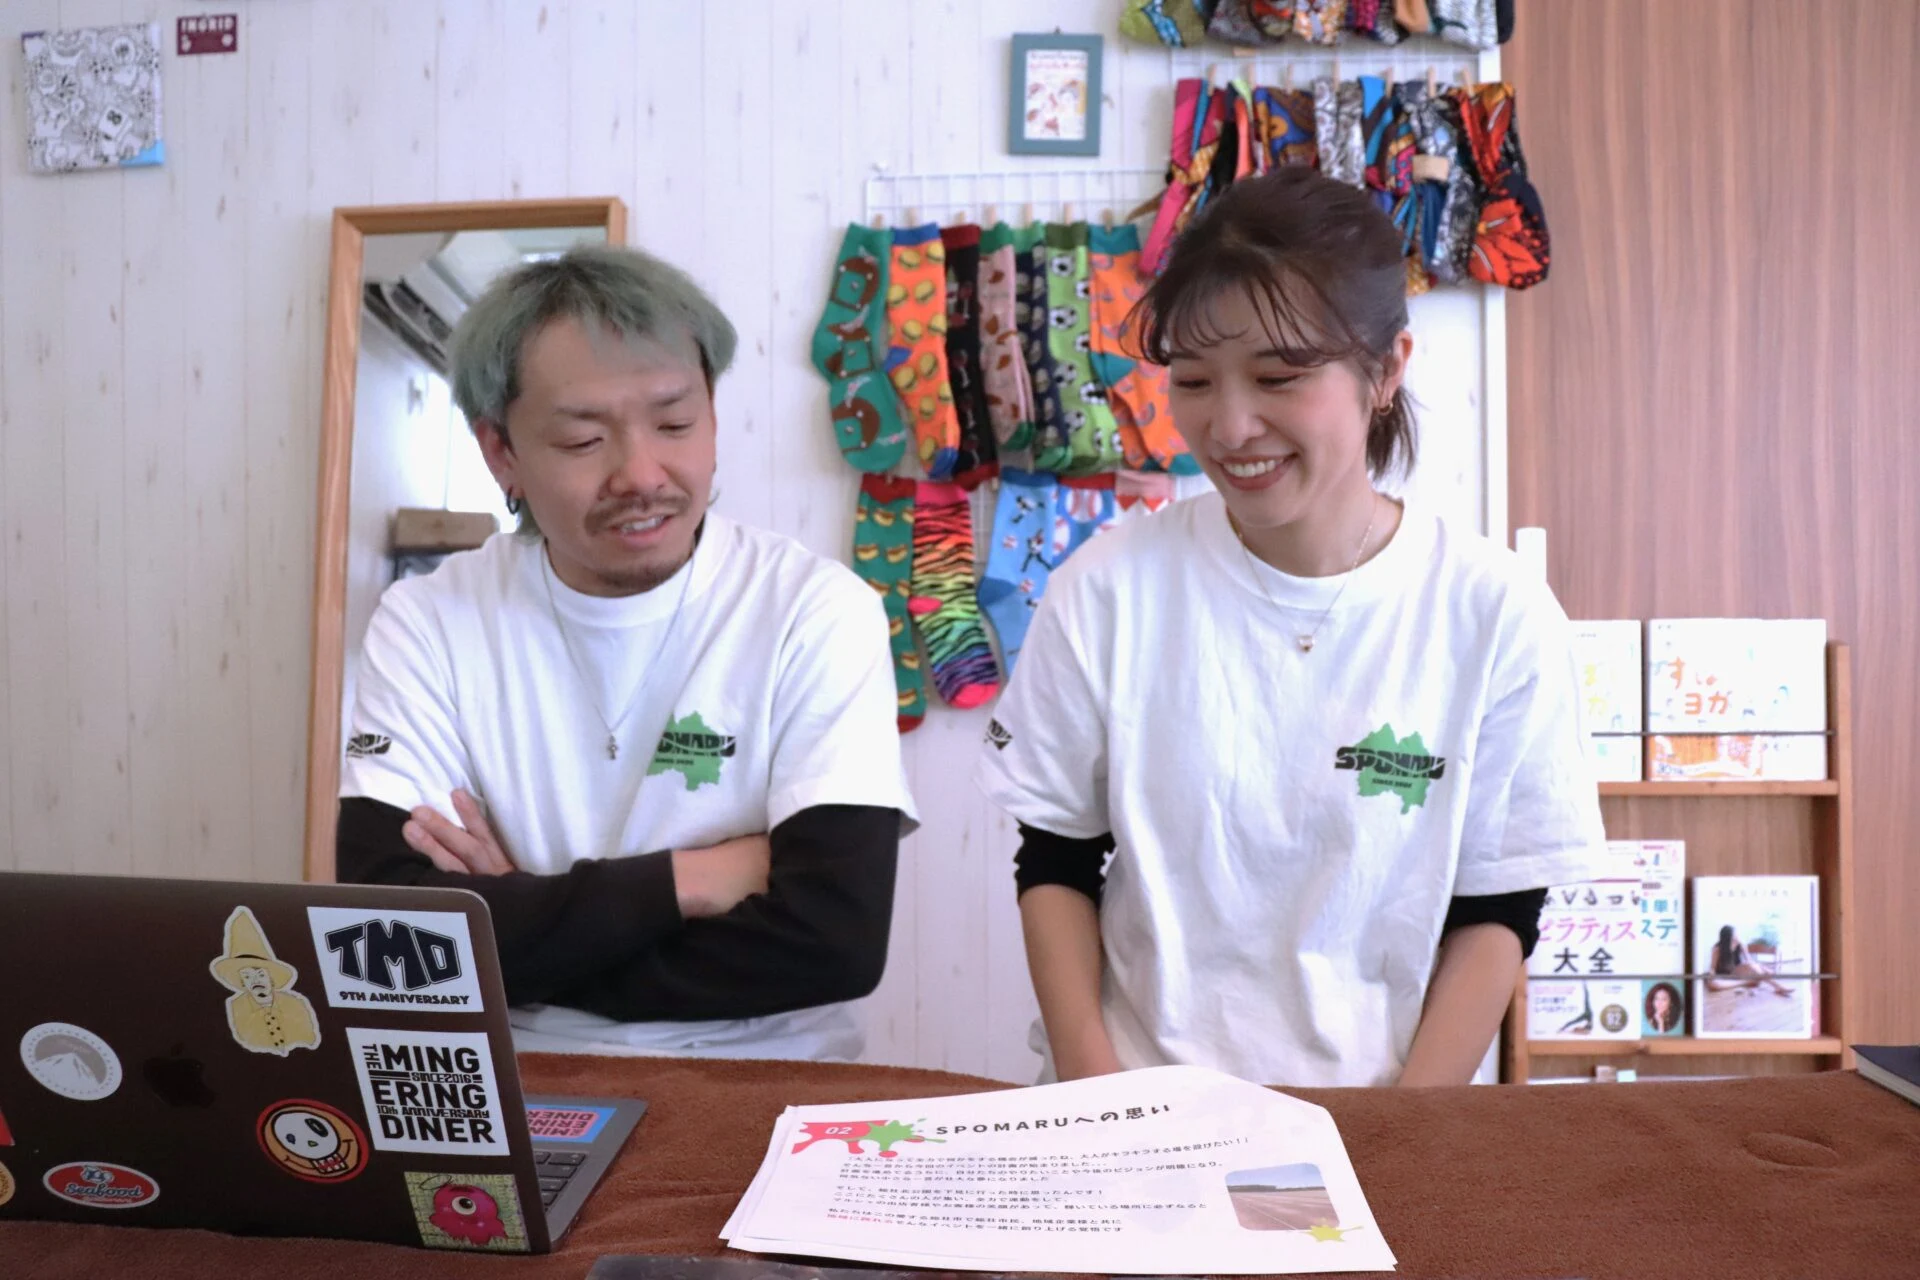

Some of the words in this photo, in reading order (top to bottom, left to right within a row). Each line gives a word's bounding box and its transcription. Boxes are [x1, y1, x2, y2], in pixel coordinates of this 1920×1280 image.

[1553, 947, 1614, 973] 大全
[339, 991, 367, 1002] 9TH
[370, 992, 469, 1005] ANNIVERSARY
[362, 1044, 382, 1070] THE
[381, 1044, 480, 1073] MING
[370, 1080, 487, 1109] ERING
[379, 1114, 496, 1144] DINER
[825, 1126, 853, 1135] 02
[66, 1182, 141, 1197] Seafood
